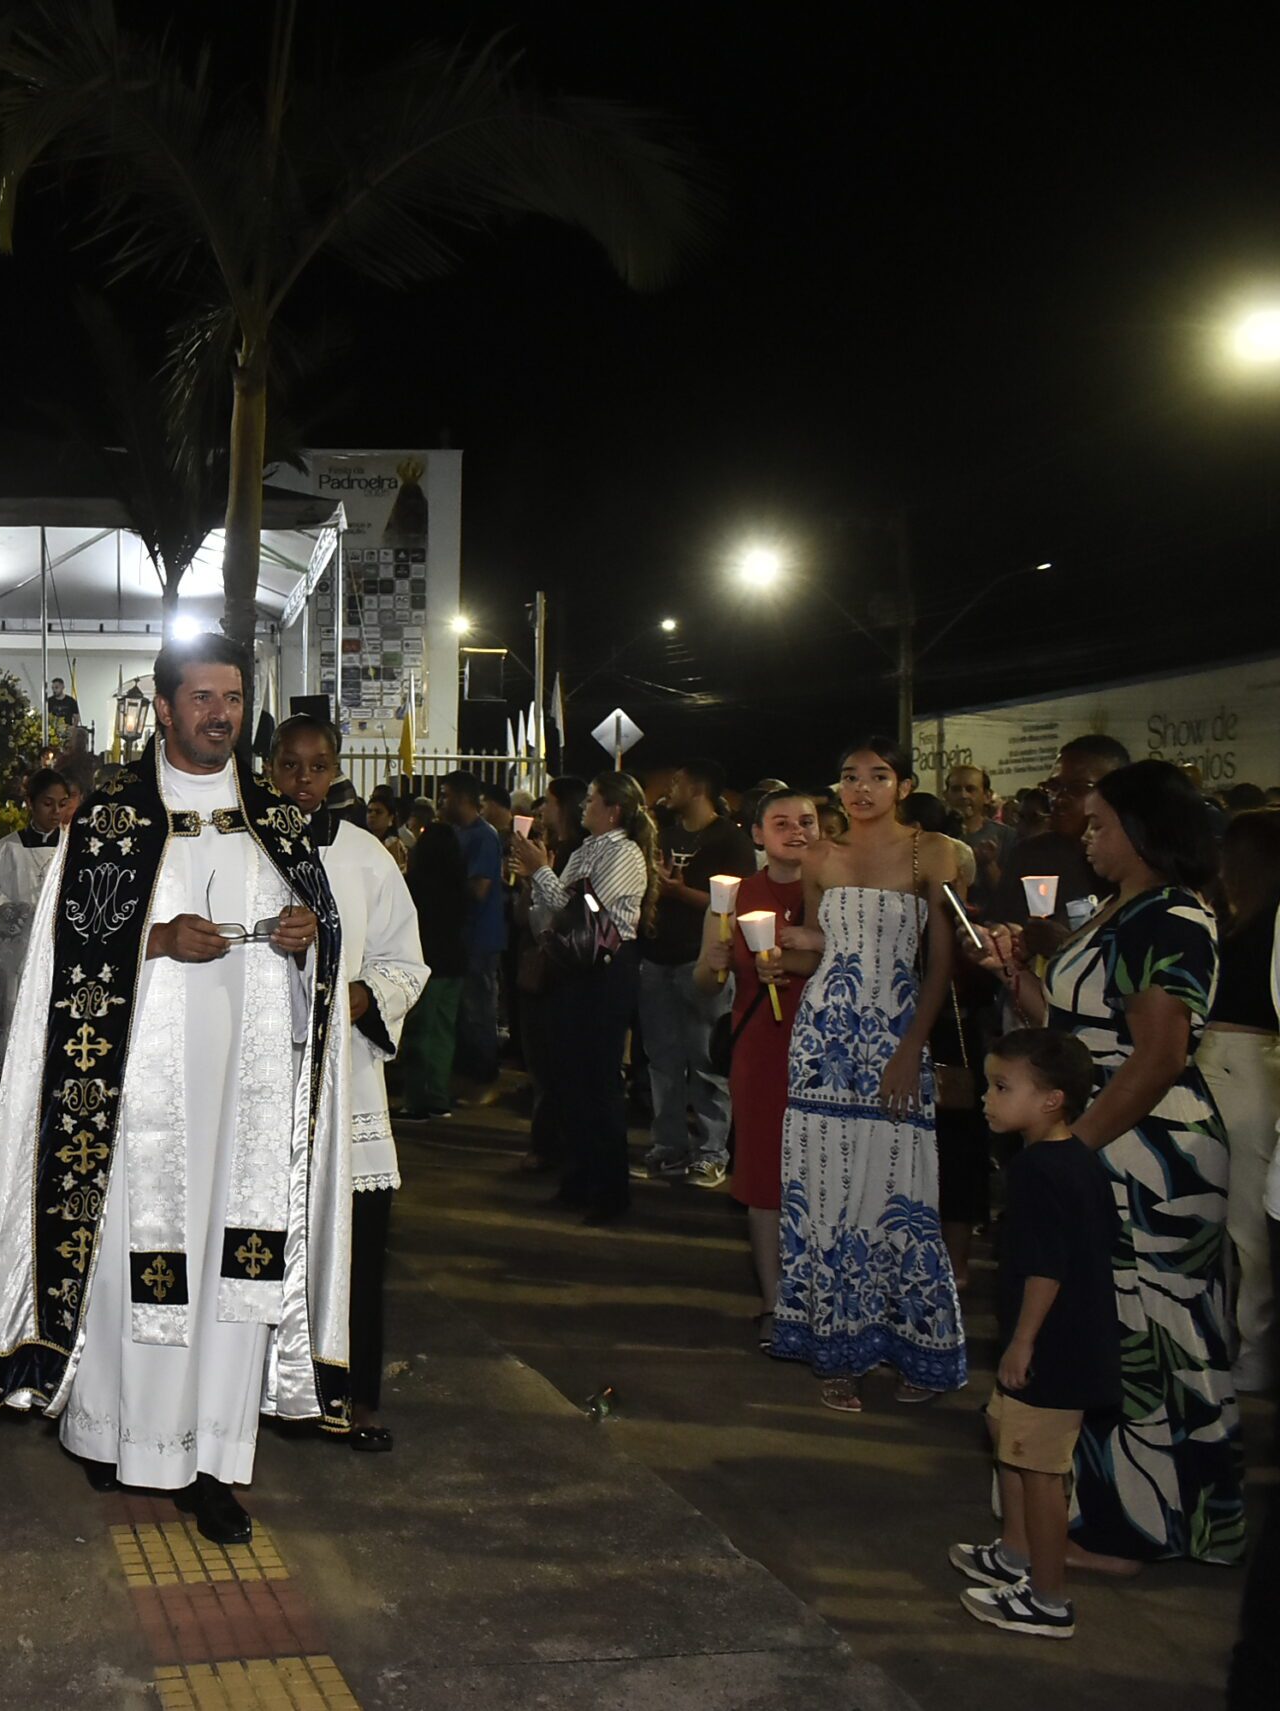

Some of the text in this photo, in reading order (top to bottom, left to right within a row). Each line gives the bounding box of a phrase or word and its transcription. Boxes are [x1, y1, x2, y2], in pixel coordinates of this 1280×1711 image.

[319, 473, 398, 490] Padroeira
[1147, 705, 1238, 750] Show de
